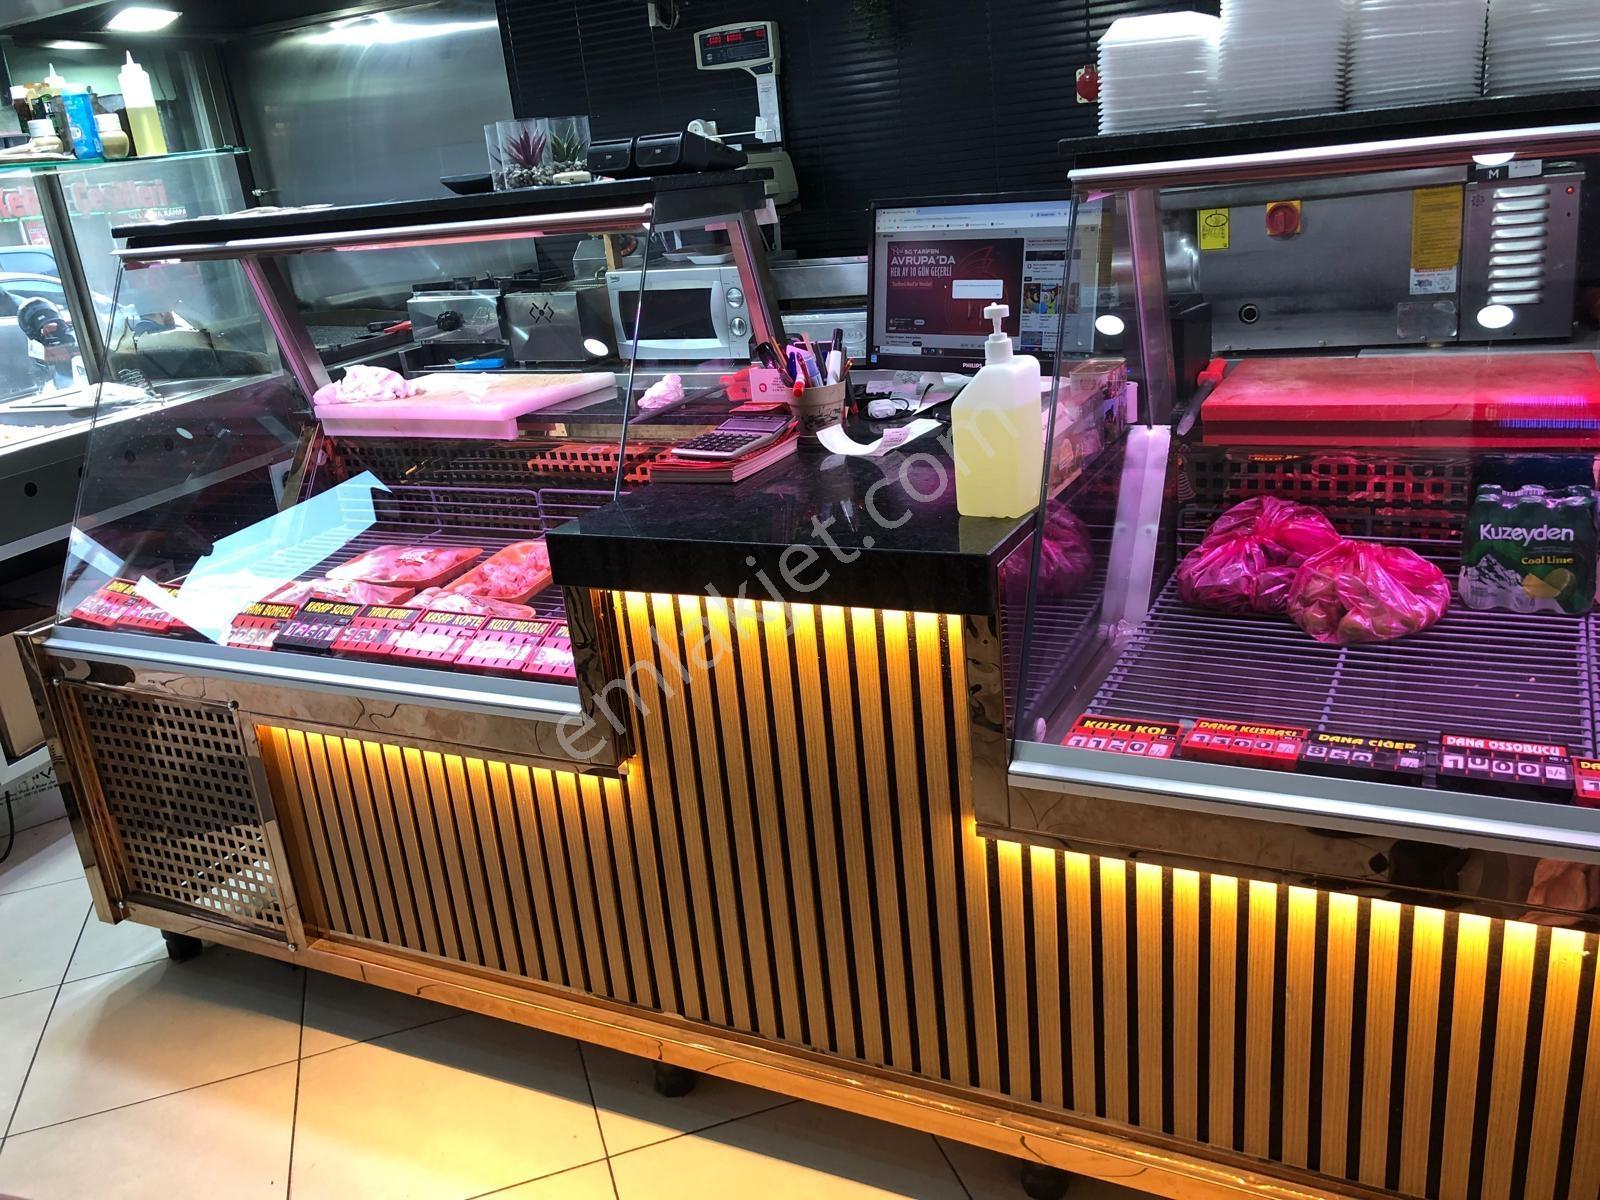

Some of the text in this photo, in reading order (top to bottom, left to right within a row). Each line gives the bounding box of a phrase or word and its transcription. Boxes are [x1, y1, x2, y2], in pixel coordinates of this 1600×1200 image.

[891, 255, 956, 266] AVRUPA'DA
[891, 265, 952, 278] HER AY 10 GÜN GEÇERLİ
[1480, 524, 1574, 546] Kuzeyden
[1521, 556, 1574, 565] Cool Lime
[304, 601, 360, 616] KASAP SUCUK
[423, 611, 453, 624] KASAP
[487, 618, 513, 632] KUZU
[1084, 720, 1132, 732] KUZU
[1198, 721, 1237, 731] DANA
[1318, 734, 1364, 745] DANA
[1446, 736, 1560, 756] DANA OSSOBUCU
